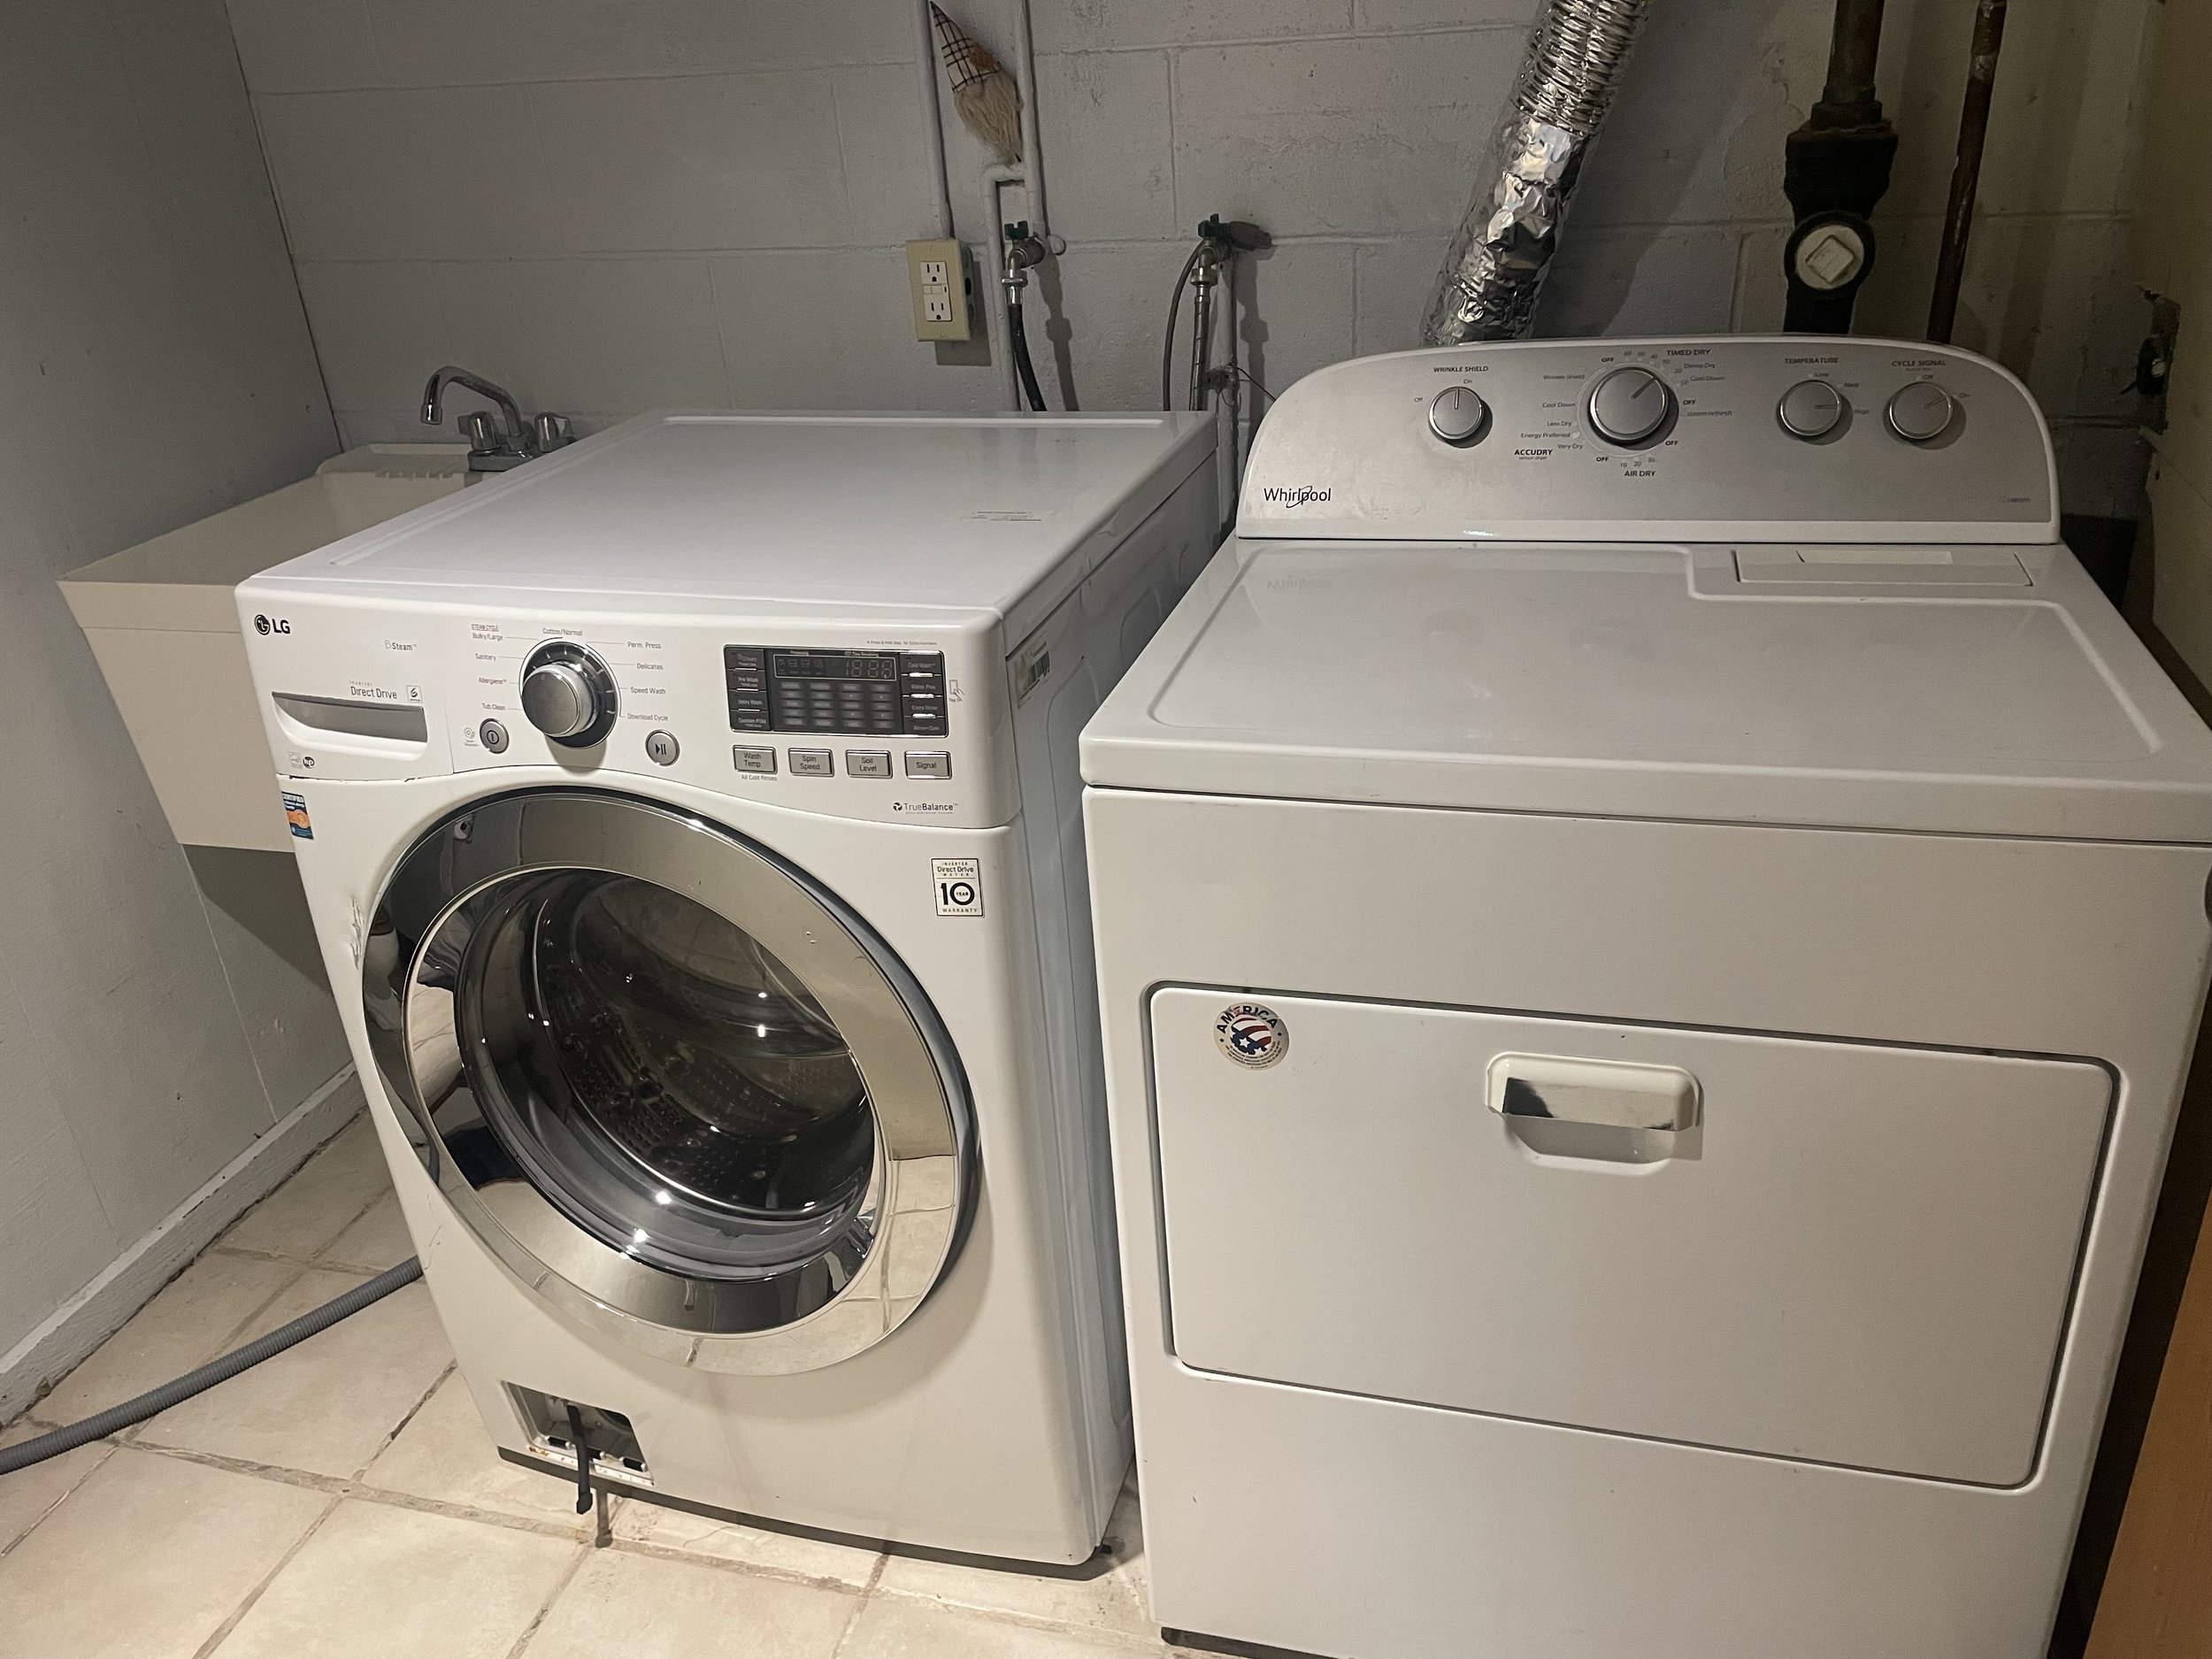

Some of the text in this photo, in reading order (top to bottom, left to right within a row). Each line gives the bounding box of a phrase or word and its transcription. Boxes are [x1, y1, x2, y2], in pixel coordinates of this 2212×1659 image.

[1263, 486, 1331, 508] Whirlpool
[272, 618, 291, 634] LG
[542, 627, 583, 636] Cotton/Normal
[350, 686, 375, 698] Direct
[376, 687, 397, 699] Drive
[627, 712, 654, 721] Download
[941, 881, 975, 906] 10
[1217, 1005, 1278, 1034] AMERICA
